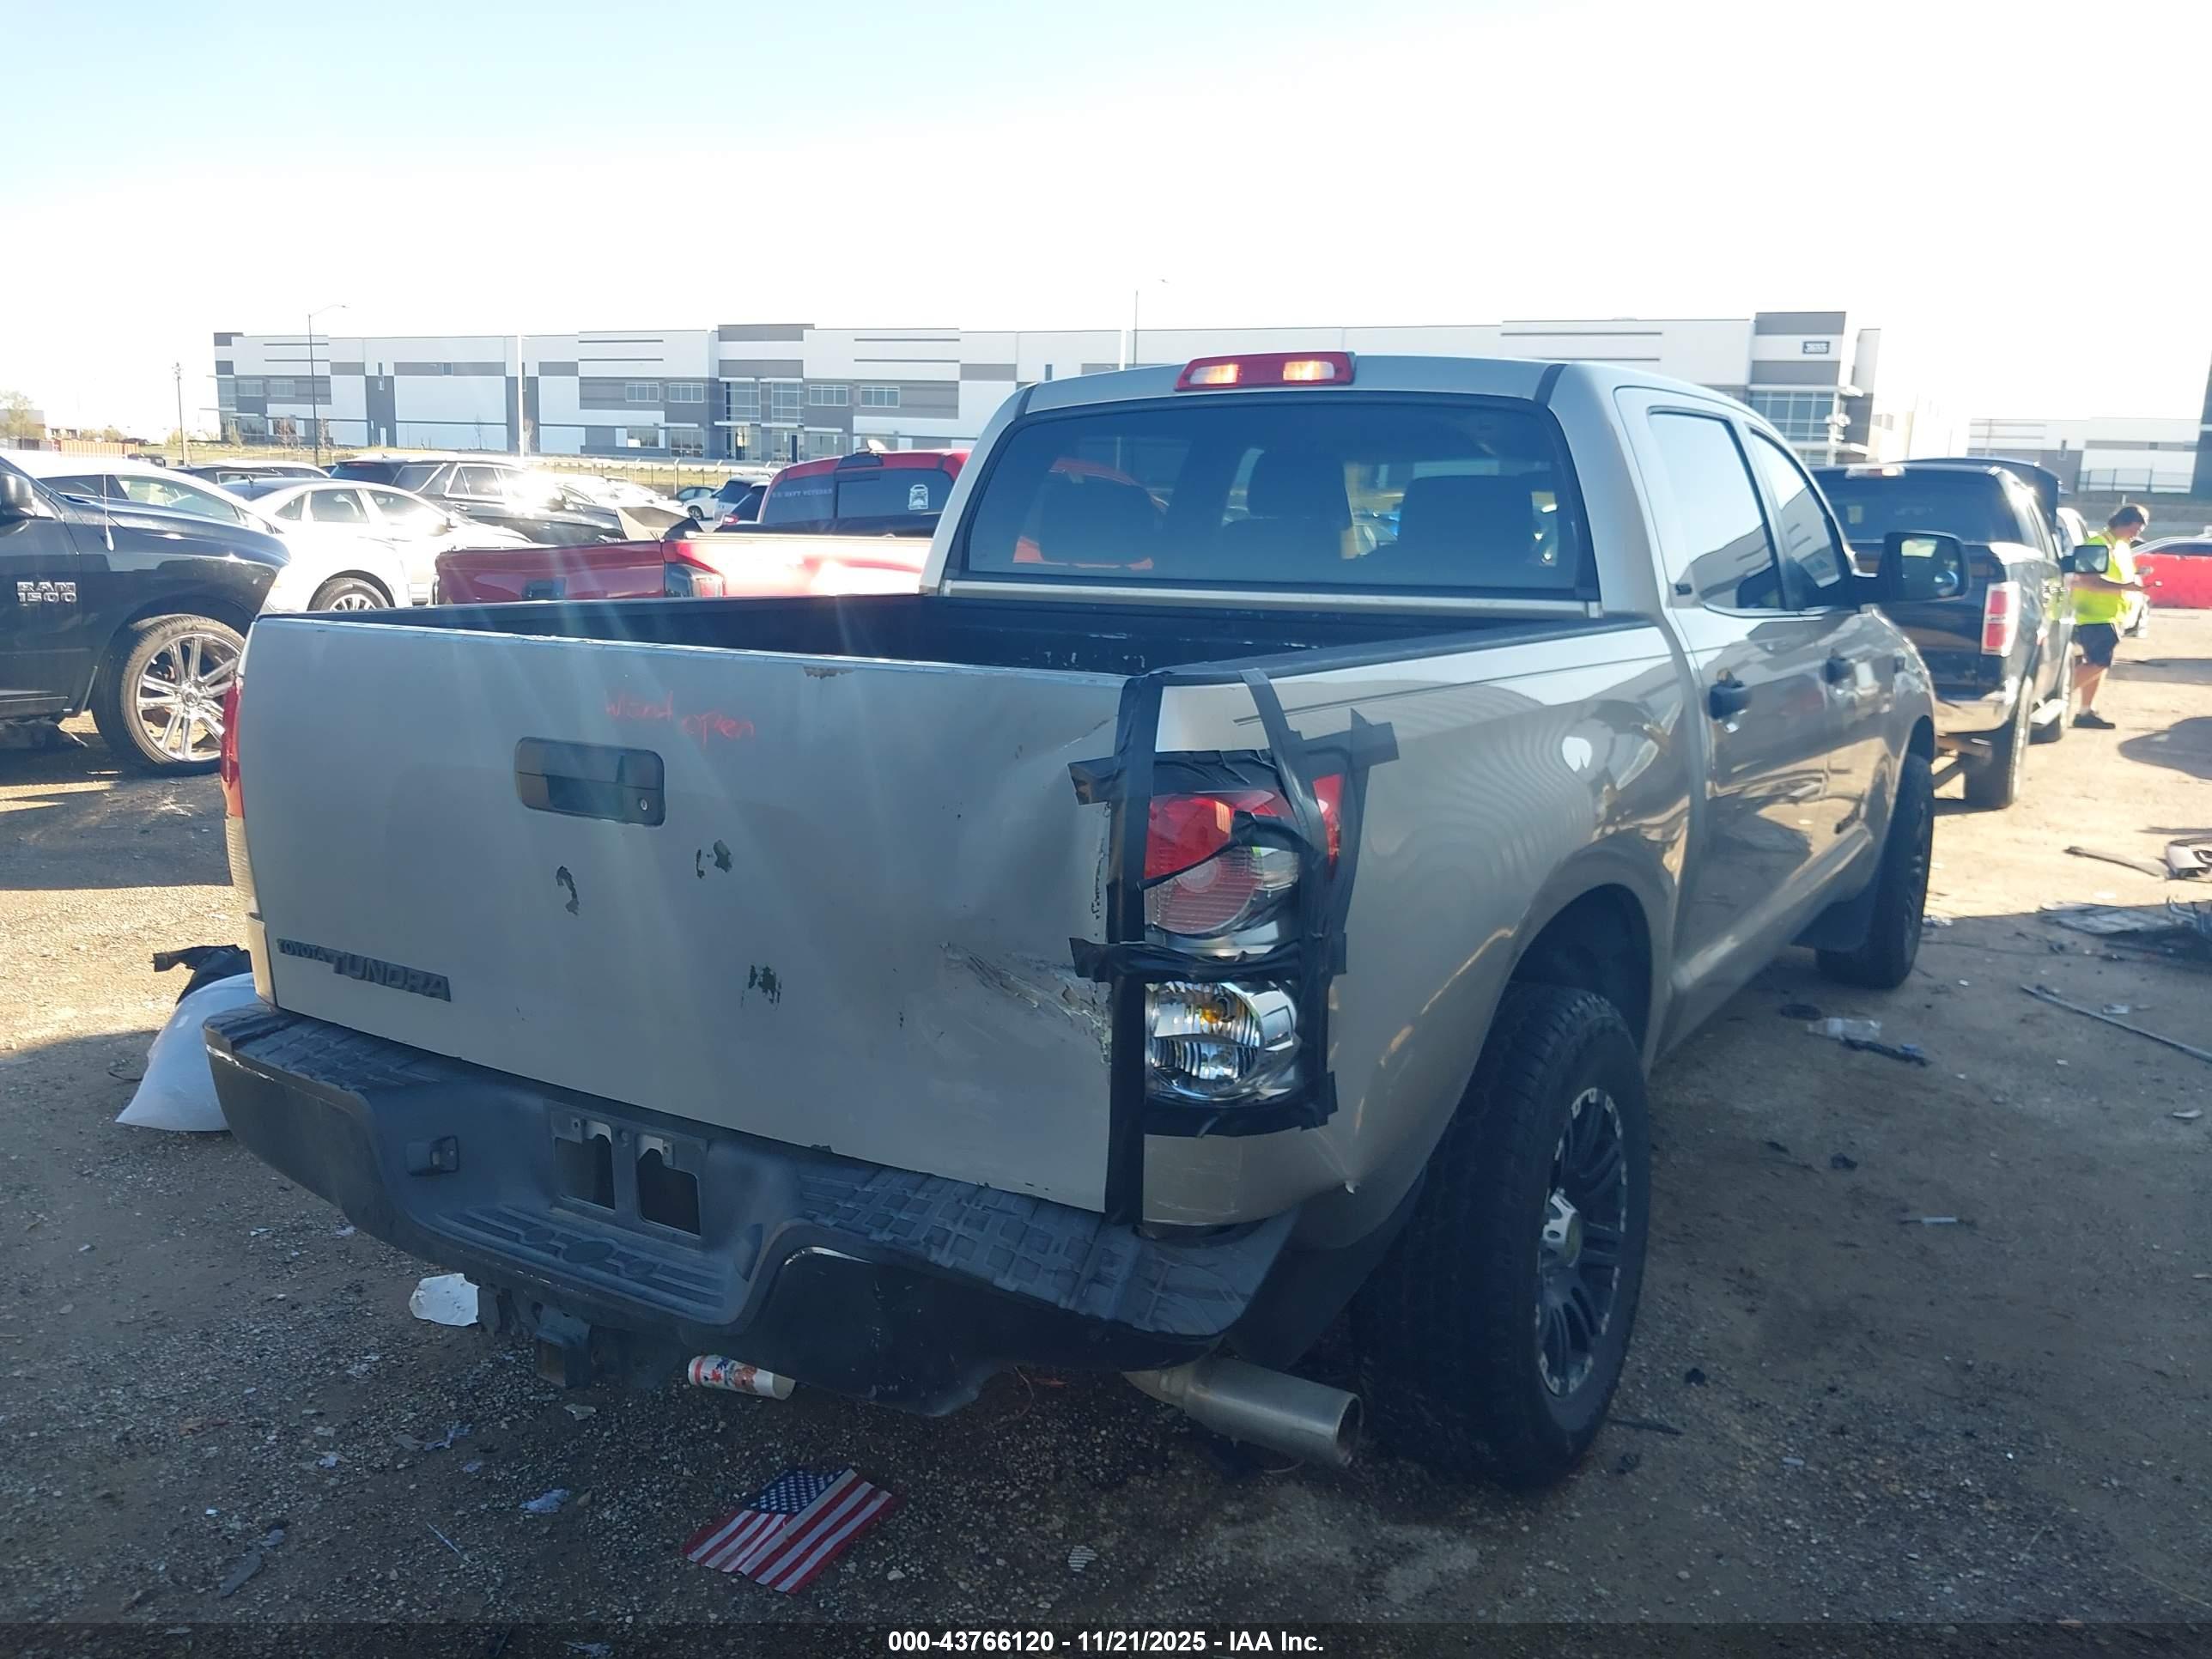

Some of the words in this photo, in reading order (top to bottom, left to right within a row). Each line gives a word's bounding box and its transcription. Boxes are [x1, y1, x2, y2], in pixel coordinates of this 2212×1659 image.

[16, 580, 76, 592] RAM
[17, 592, 78, 603] 1500
[277, 939, 326, 963] TOYOTA
[331, 951, 449, 1000] TUNDRA
